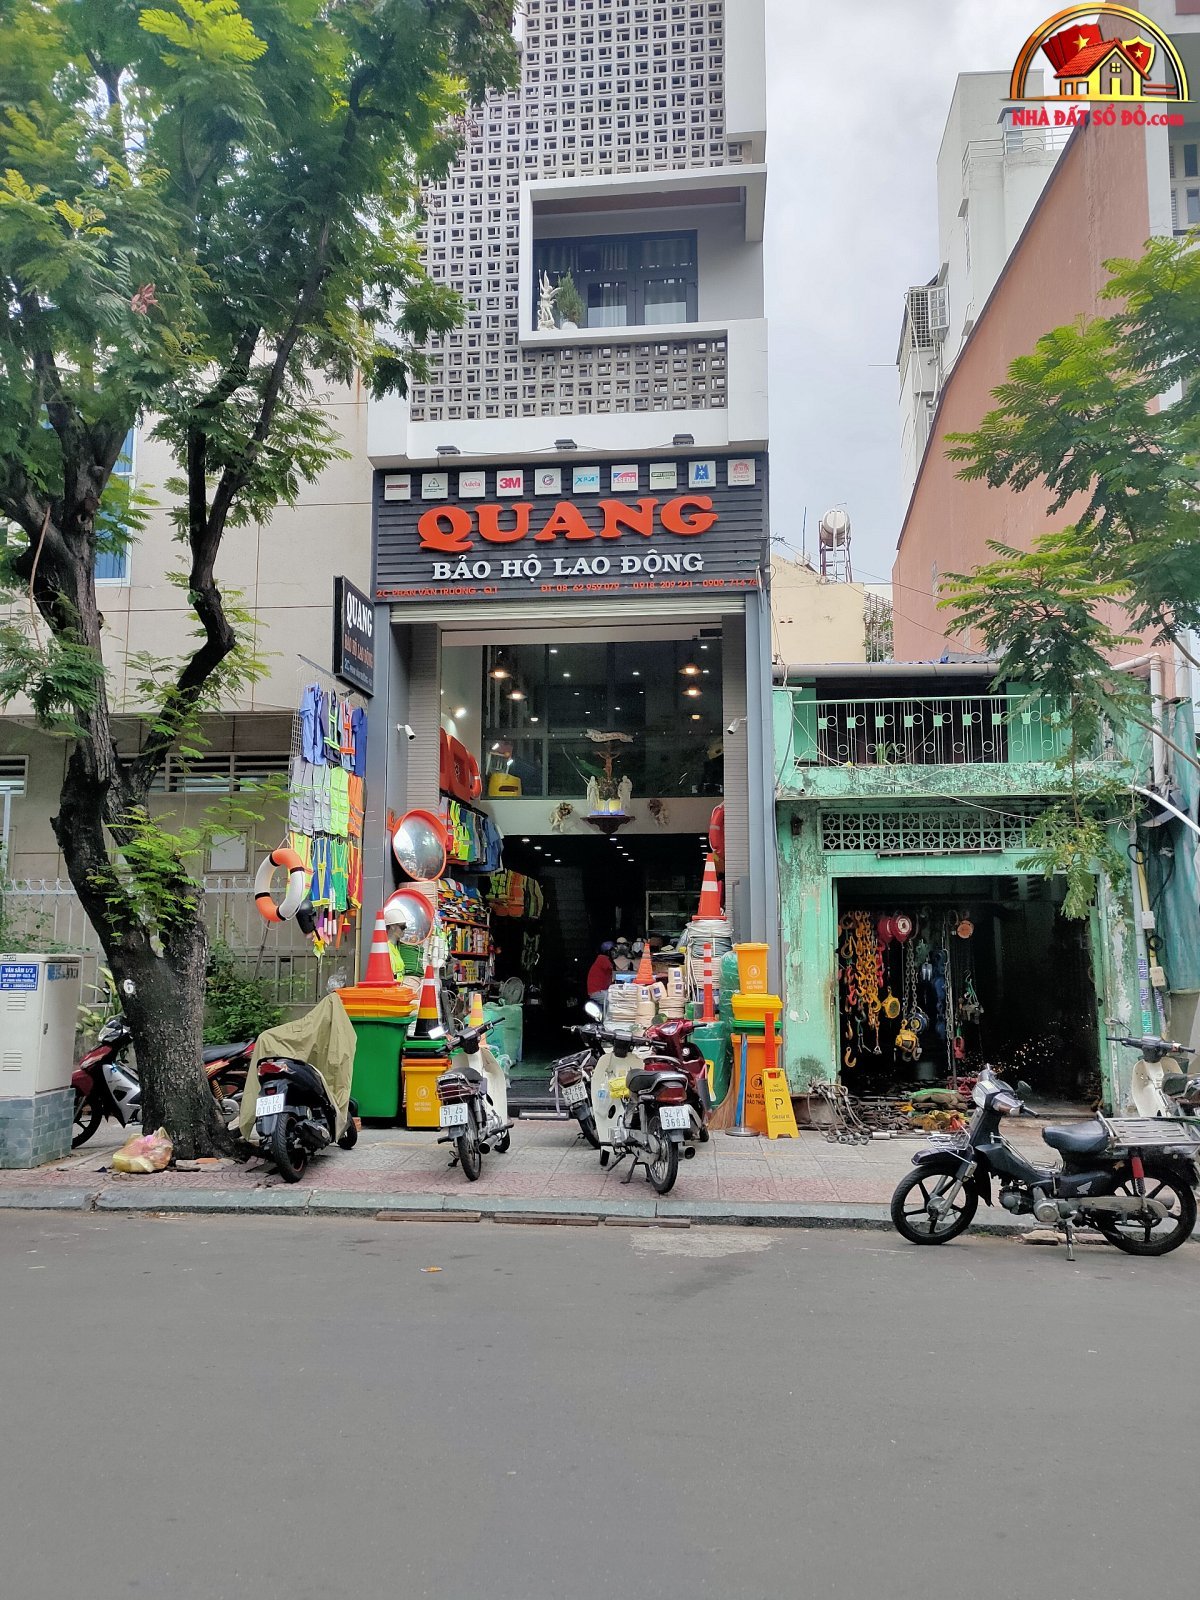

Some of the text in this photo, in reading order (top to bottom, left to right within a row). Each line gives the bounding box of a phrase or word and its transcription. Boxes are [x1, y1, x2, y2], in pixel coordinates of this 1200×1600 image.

[500, 477, 521, 489] 3M
[418, 496, 719, 553] QUANG
[432, 549, 705, 583] BẢO HỘ LAO ĐỘNG
[377, 589, 390, 598] 2C
[572, 583, 584, 592] 62
[660, 580, 676, 589] 209
[678, 580, 693, 588] 221
[347, 591, 373, 638] QUANG
[124, 979, 134, 994] 6
